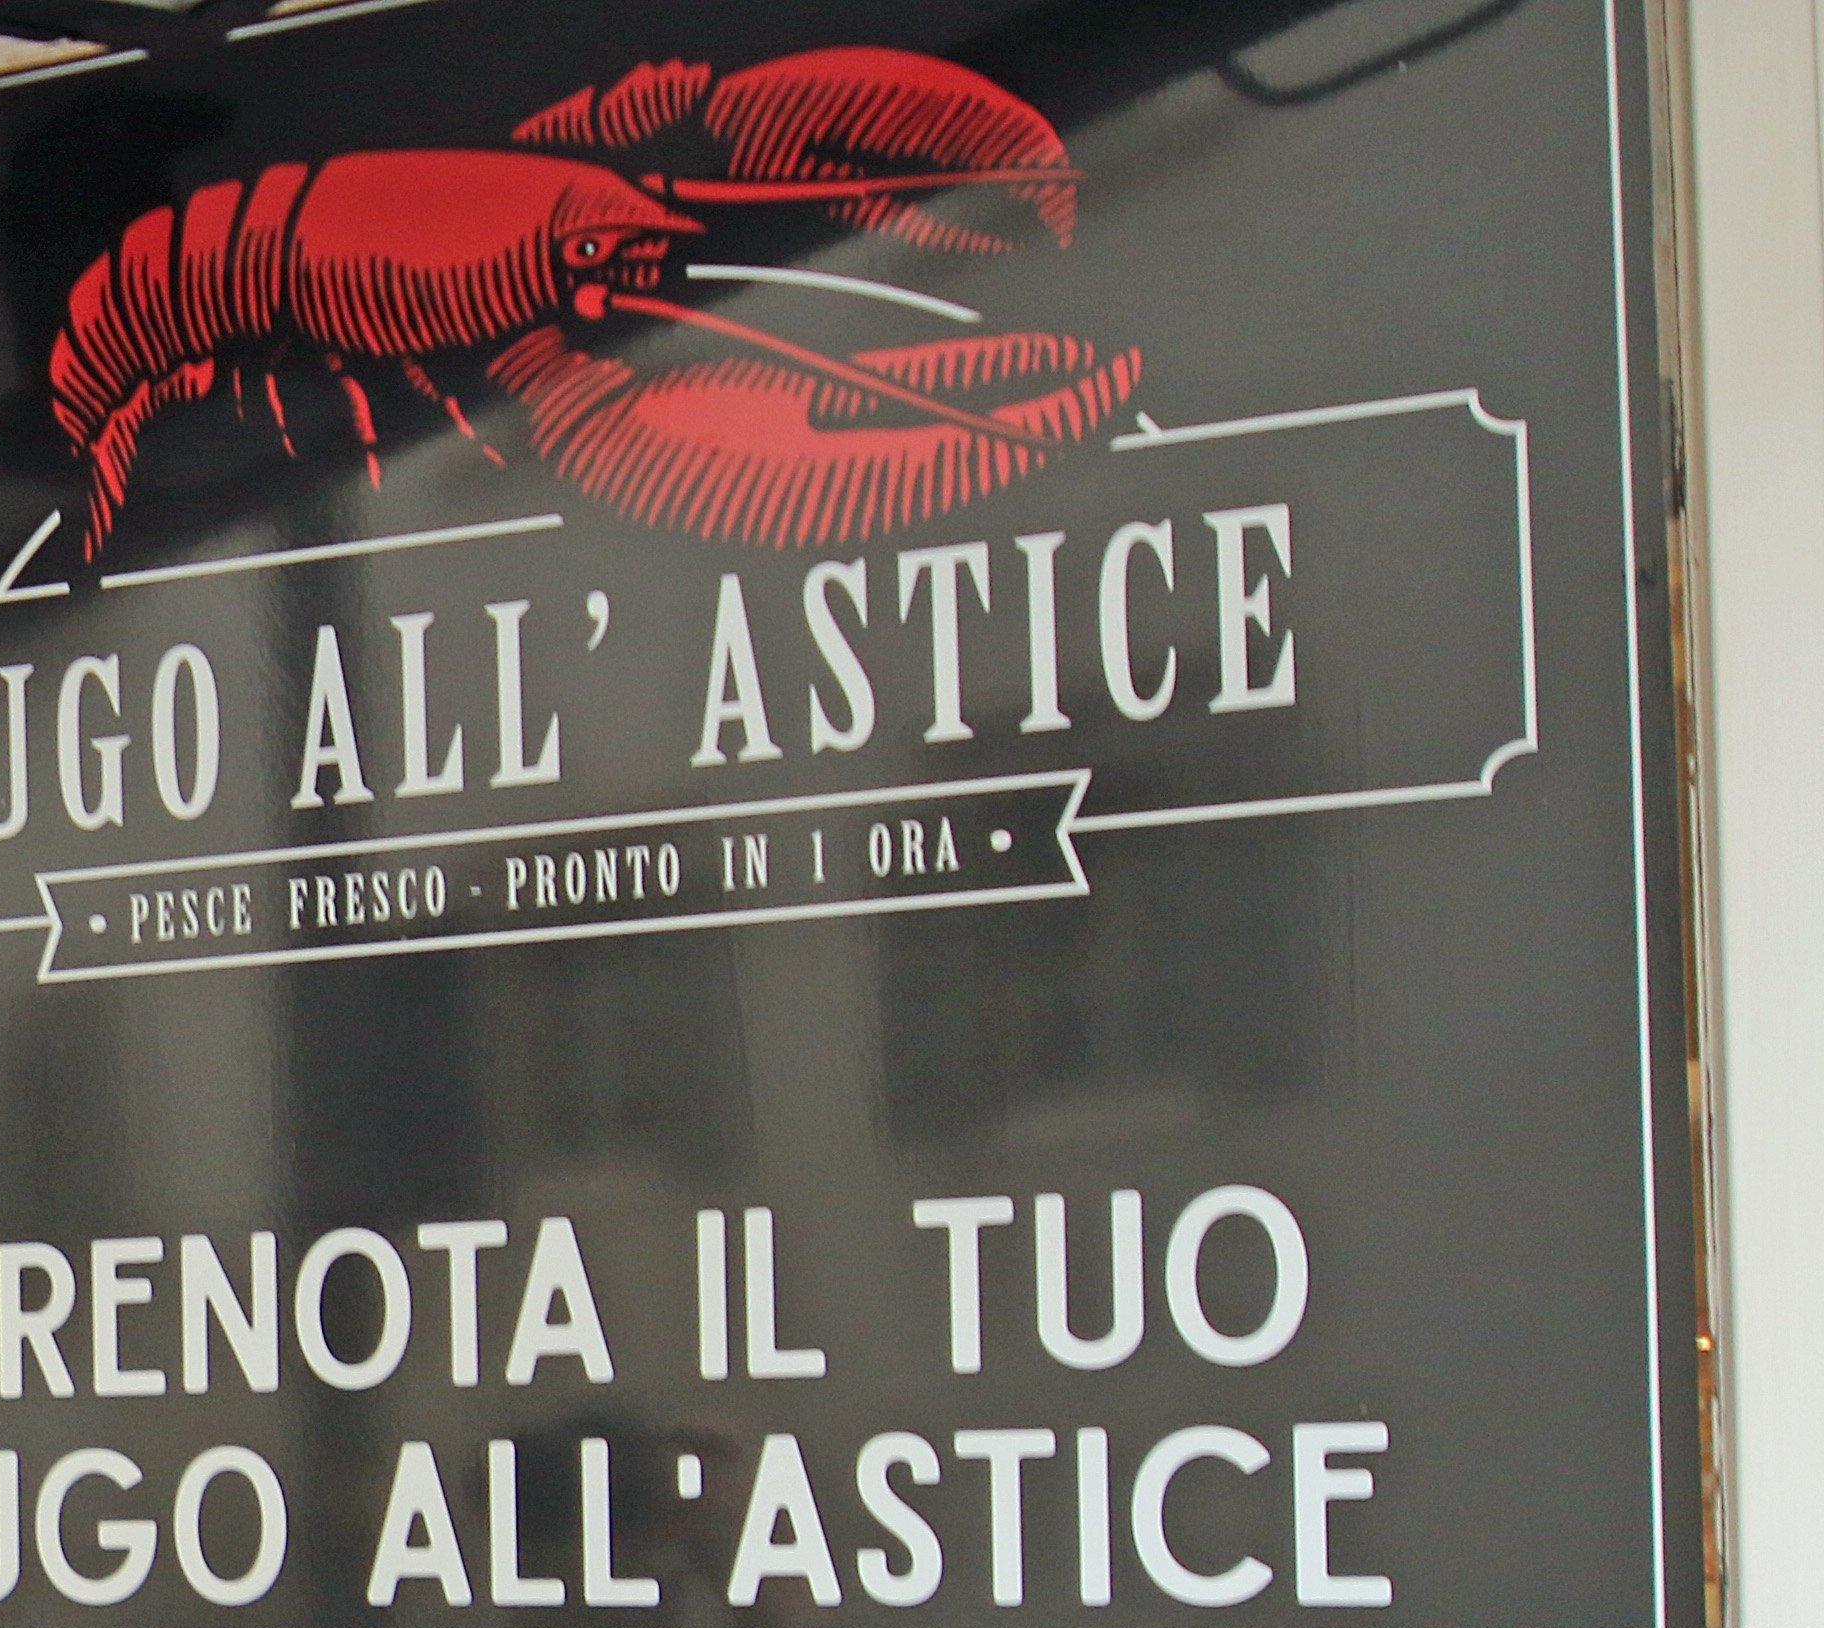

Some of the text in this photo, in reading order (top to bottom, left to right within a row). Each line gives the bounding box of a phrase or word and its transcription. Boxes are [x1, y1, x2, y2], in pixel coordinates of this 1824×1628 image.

[292, 591, 609, 808] ALL'
[691, 504, 1294, 766] ASTICE
[131, 884, 251, 943] PESCE
[289, 866, 445, 929] FRESCO
[506, 844, 679, 909] PRONTO
[723, 835, 766, 890] IN
[812, 831, 823, 882] 1
[869, 817, 958, 876] ORA
[697, 1208, 825, 1379] IL
[913, 1186, 1307, 1372] TUO
[368, 1422, 1391, 1606] ALL'ASTICE
